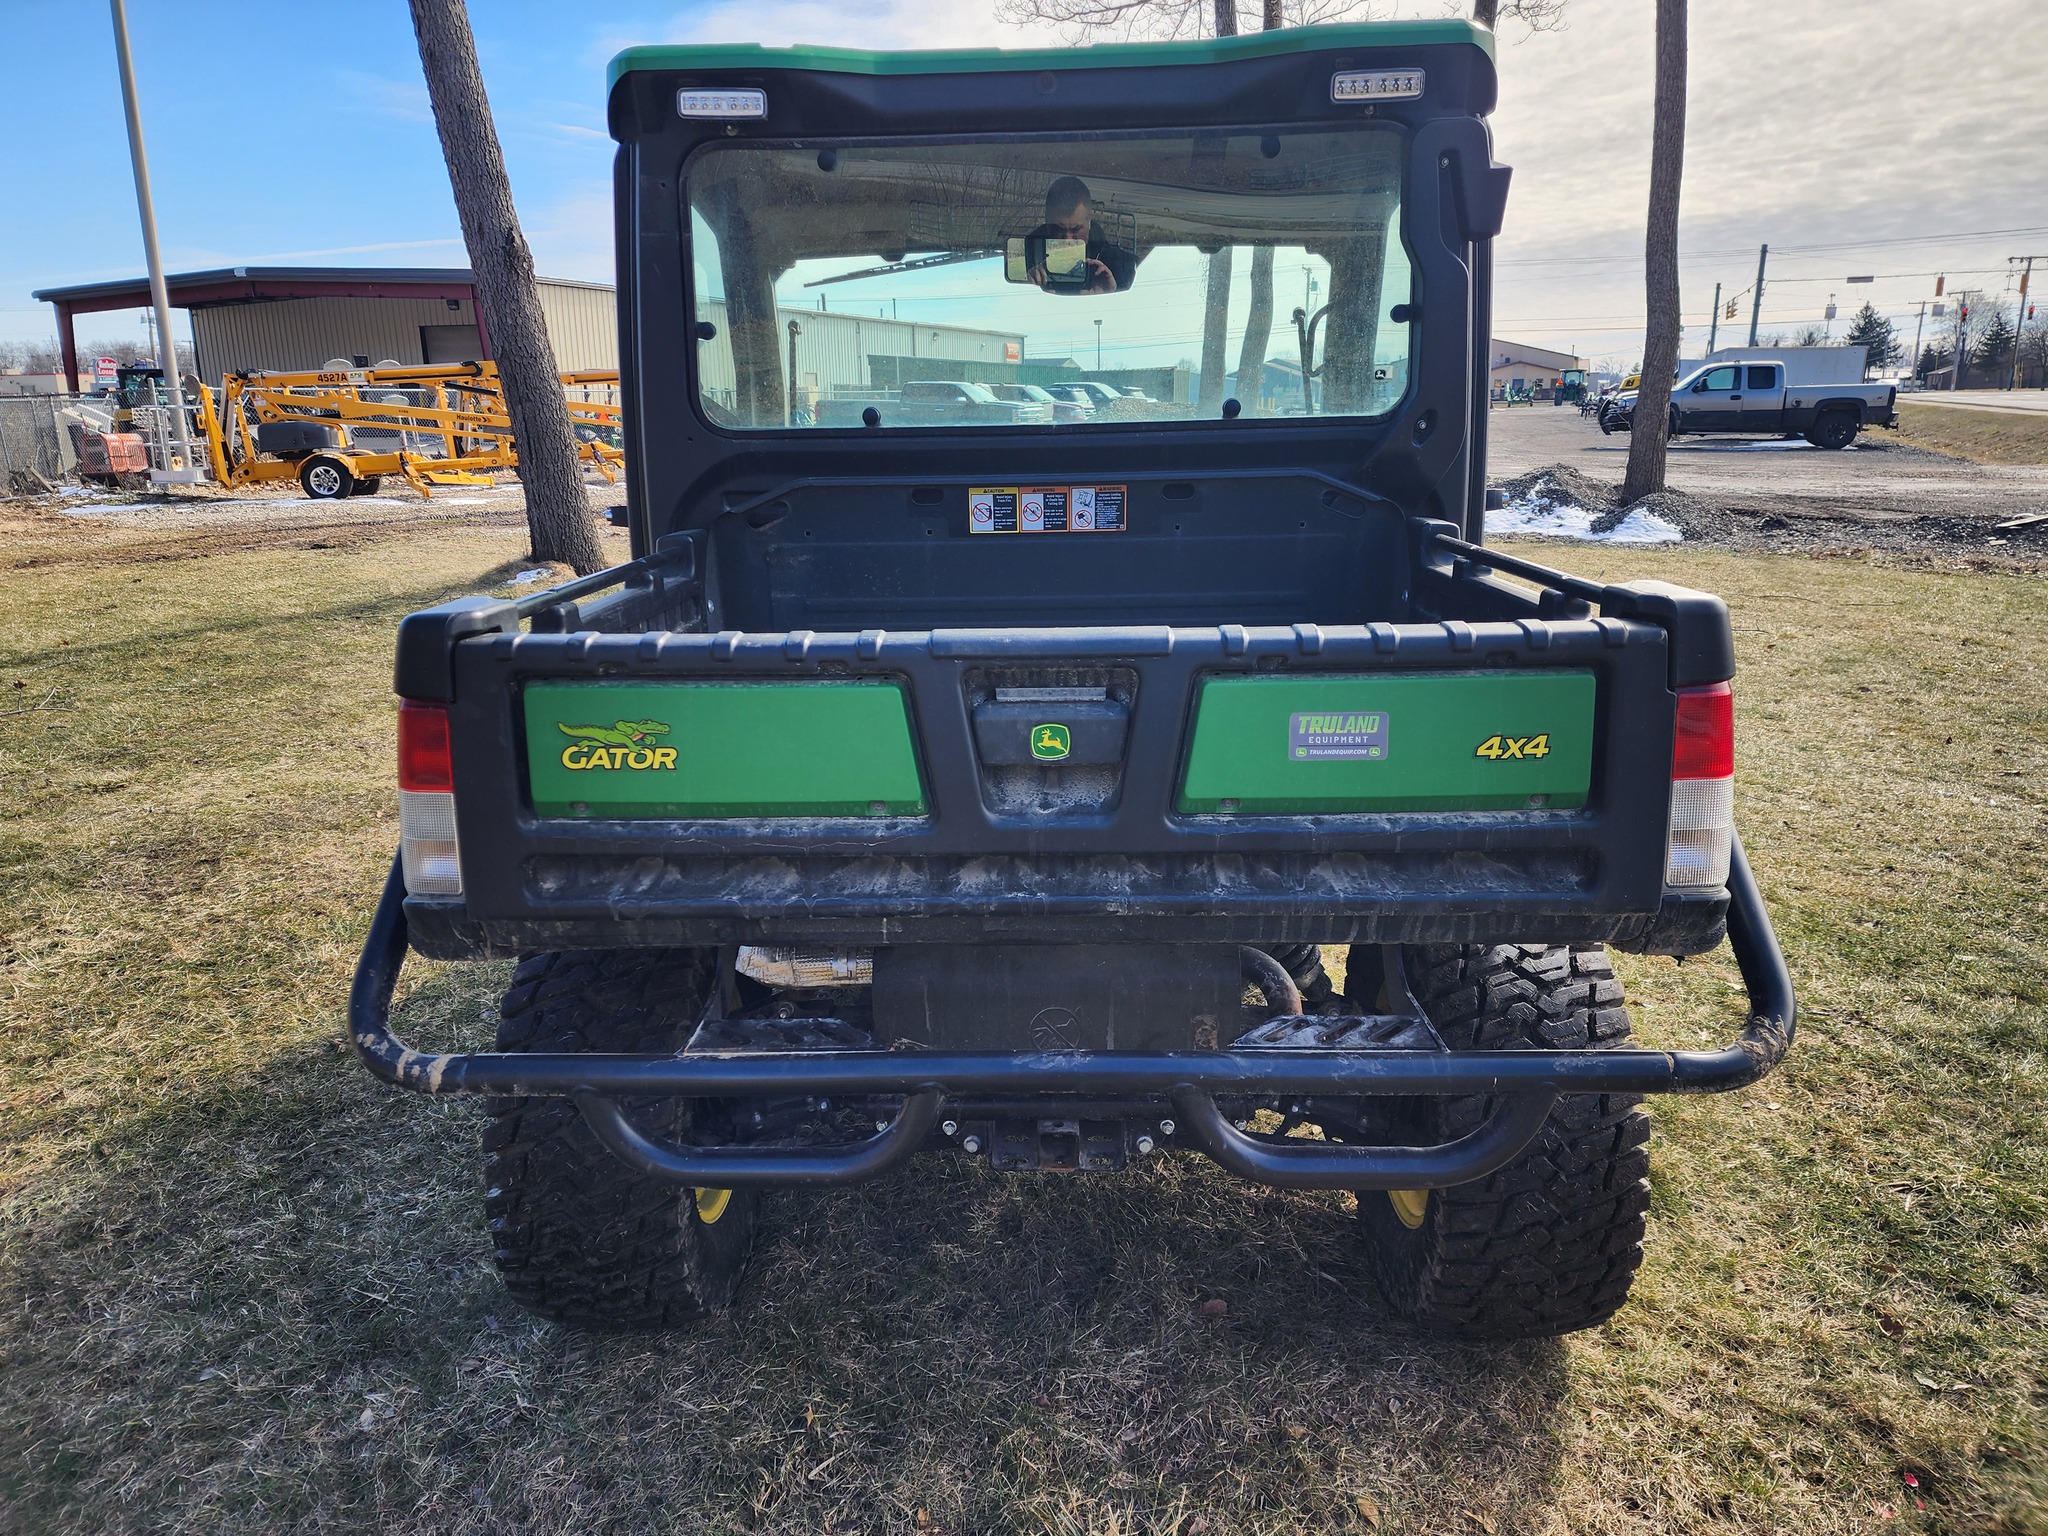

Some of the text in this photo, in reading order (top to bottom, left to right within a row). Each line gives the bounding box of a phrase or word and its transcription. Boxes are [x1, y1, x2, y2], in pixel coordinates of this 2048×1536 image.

[317, 373, 347, 382] 4527A
[456, 414, 482, 422] Haulotte
[1298, 715, 1380, 734] TRULAND
[1308, 736, 1368, 744] EQUIPMENT
[561, 745, 678, 770] GATOR
